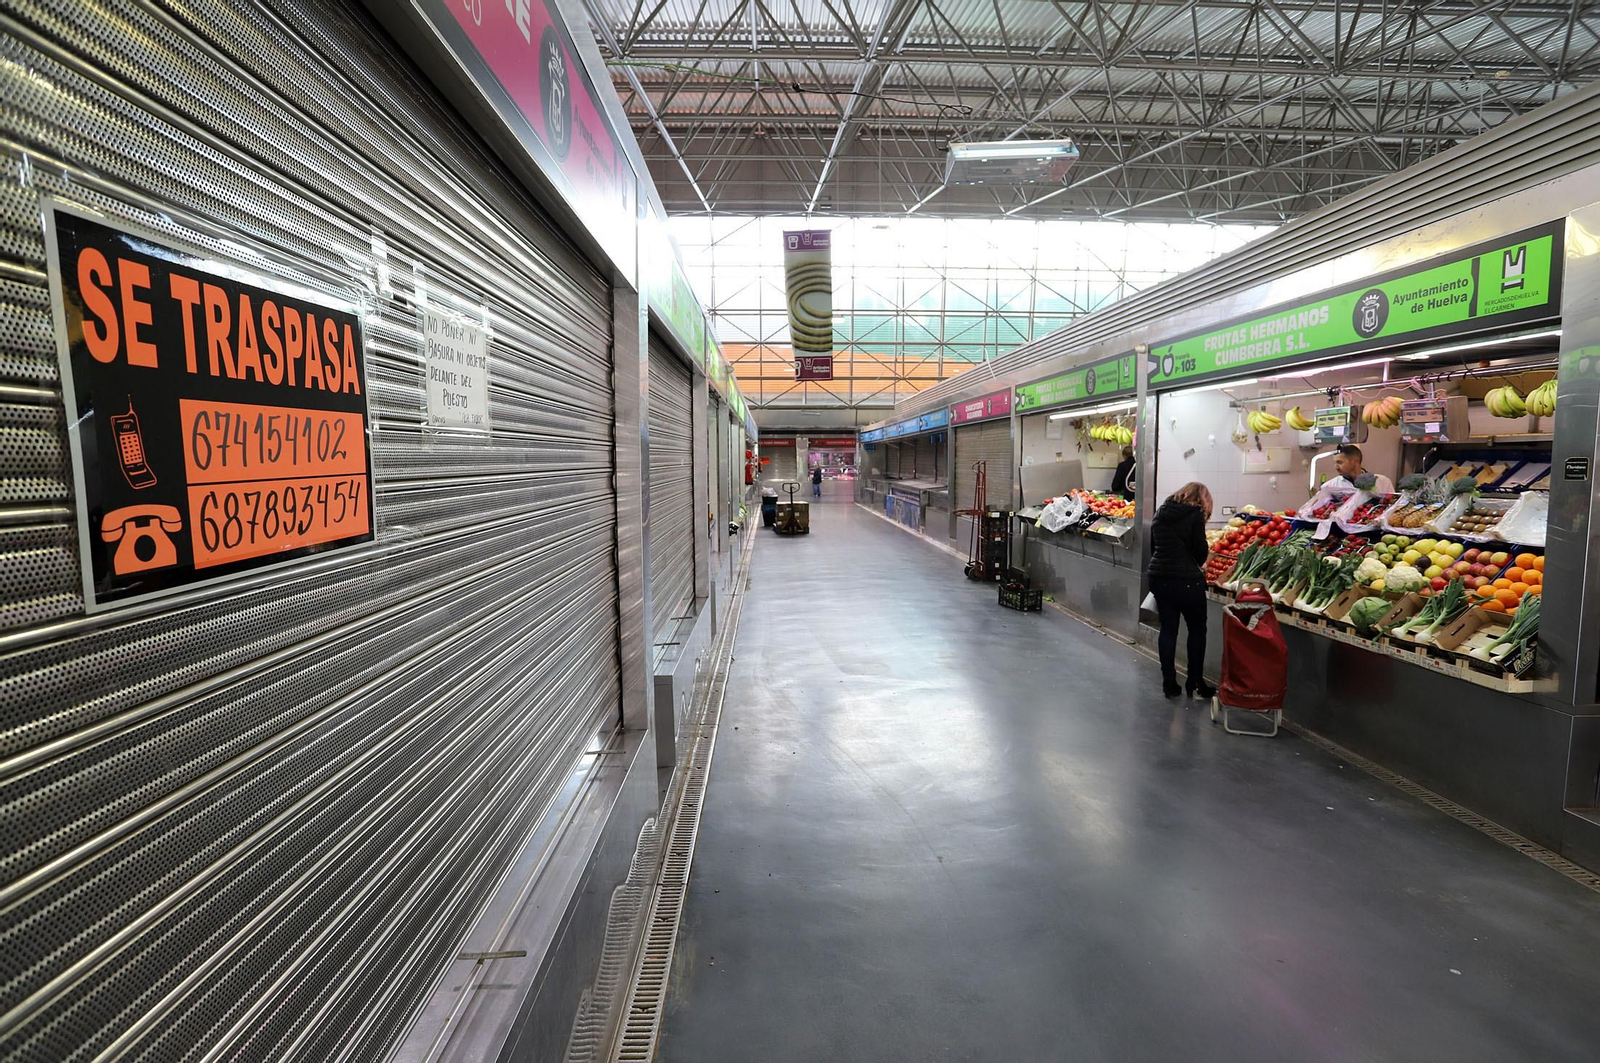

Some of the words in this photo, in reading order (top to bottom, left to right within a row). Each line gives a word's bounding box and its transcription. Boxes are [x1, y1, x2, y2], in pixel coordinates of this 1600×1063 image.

[1393, 278, 1469, 305] Ayuntamiento
[1411, 302, 1423, 314] de
[1427, 293, 1468, 310] Huelva
[78, 247, 159, 369] SE
[169, 272, 361, 396] TRASPASA
[428, 315, 438, 334] NO
[441, 320, 464, 341] PONER
[1204, 328, 1248, 352] FRUTAS
[1250, 305, 1330, 341] HERMANOS
[428, 338, 454, 362] BASURA
[1215, 338, 1282, 366] CUMBRERA
[1285, 333, 1311, 351] S.L.
[430, 366, 457, 386] DELANTE
[461, 374, 472, 388] DEL
[442, 388, 468, 409] PUESTO
[191, 410, 347, 471] 674154102
[200, 479, 361, 553] 687893454
